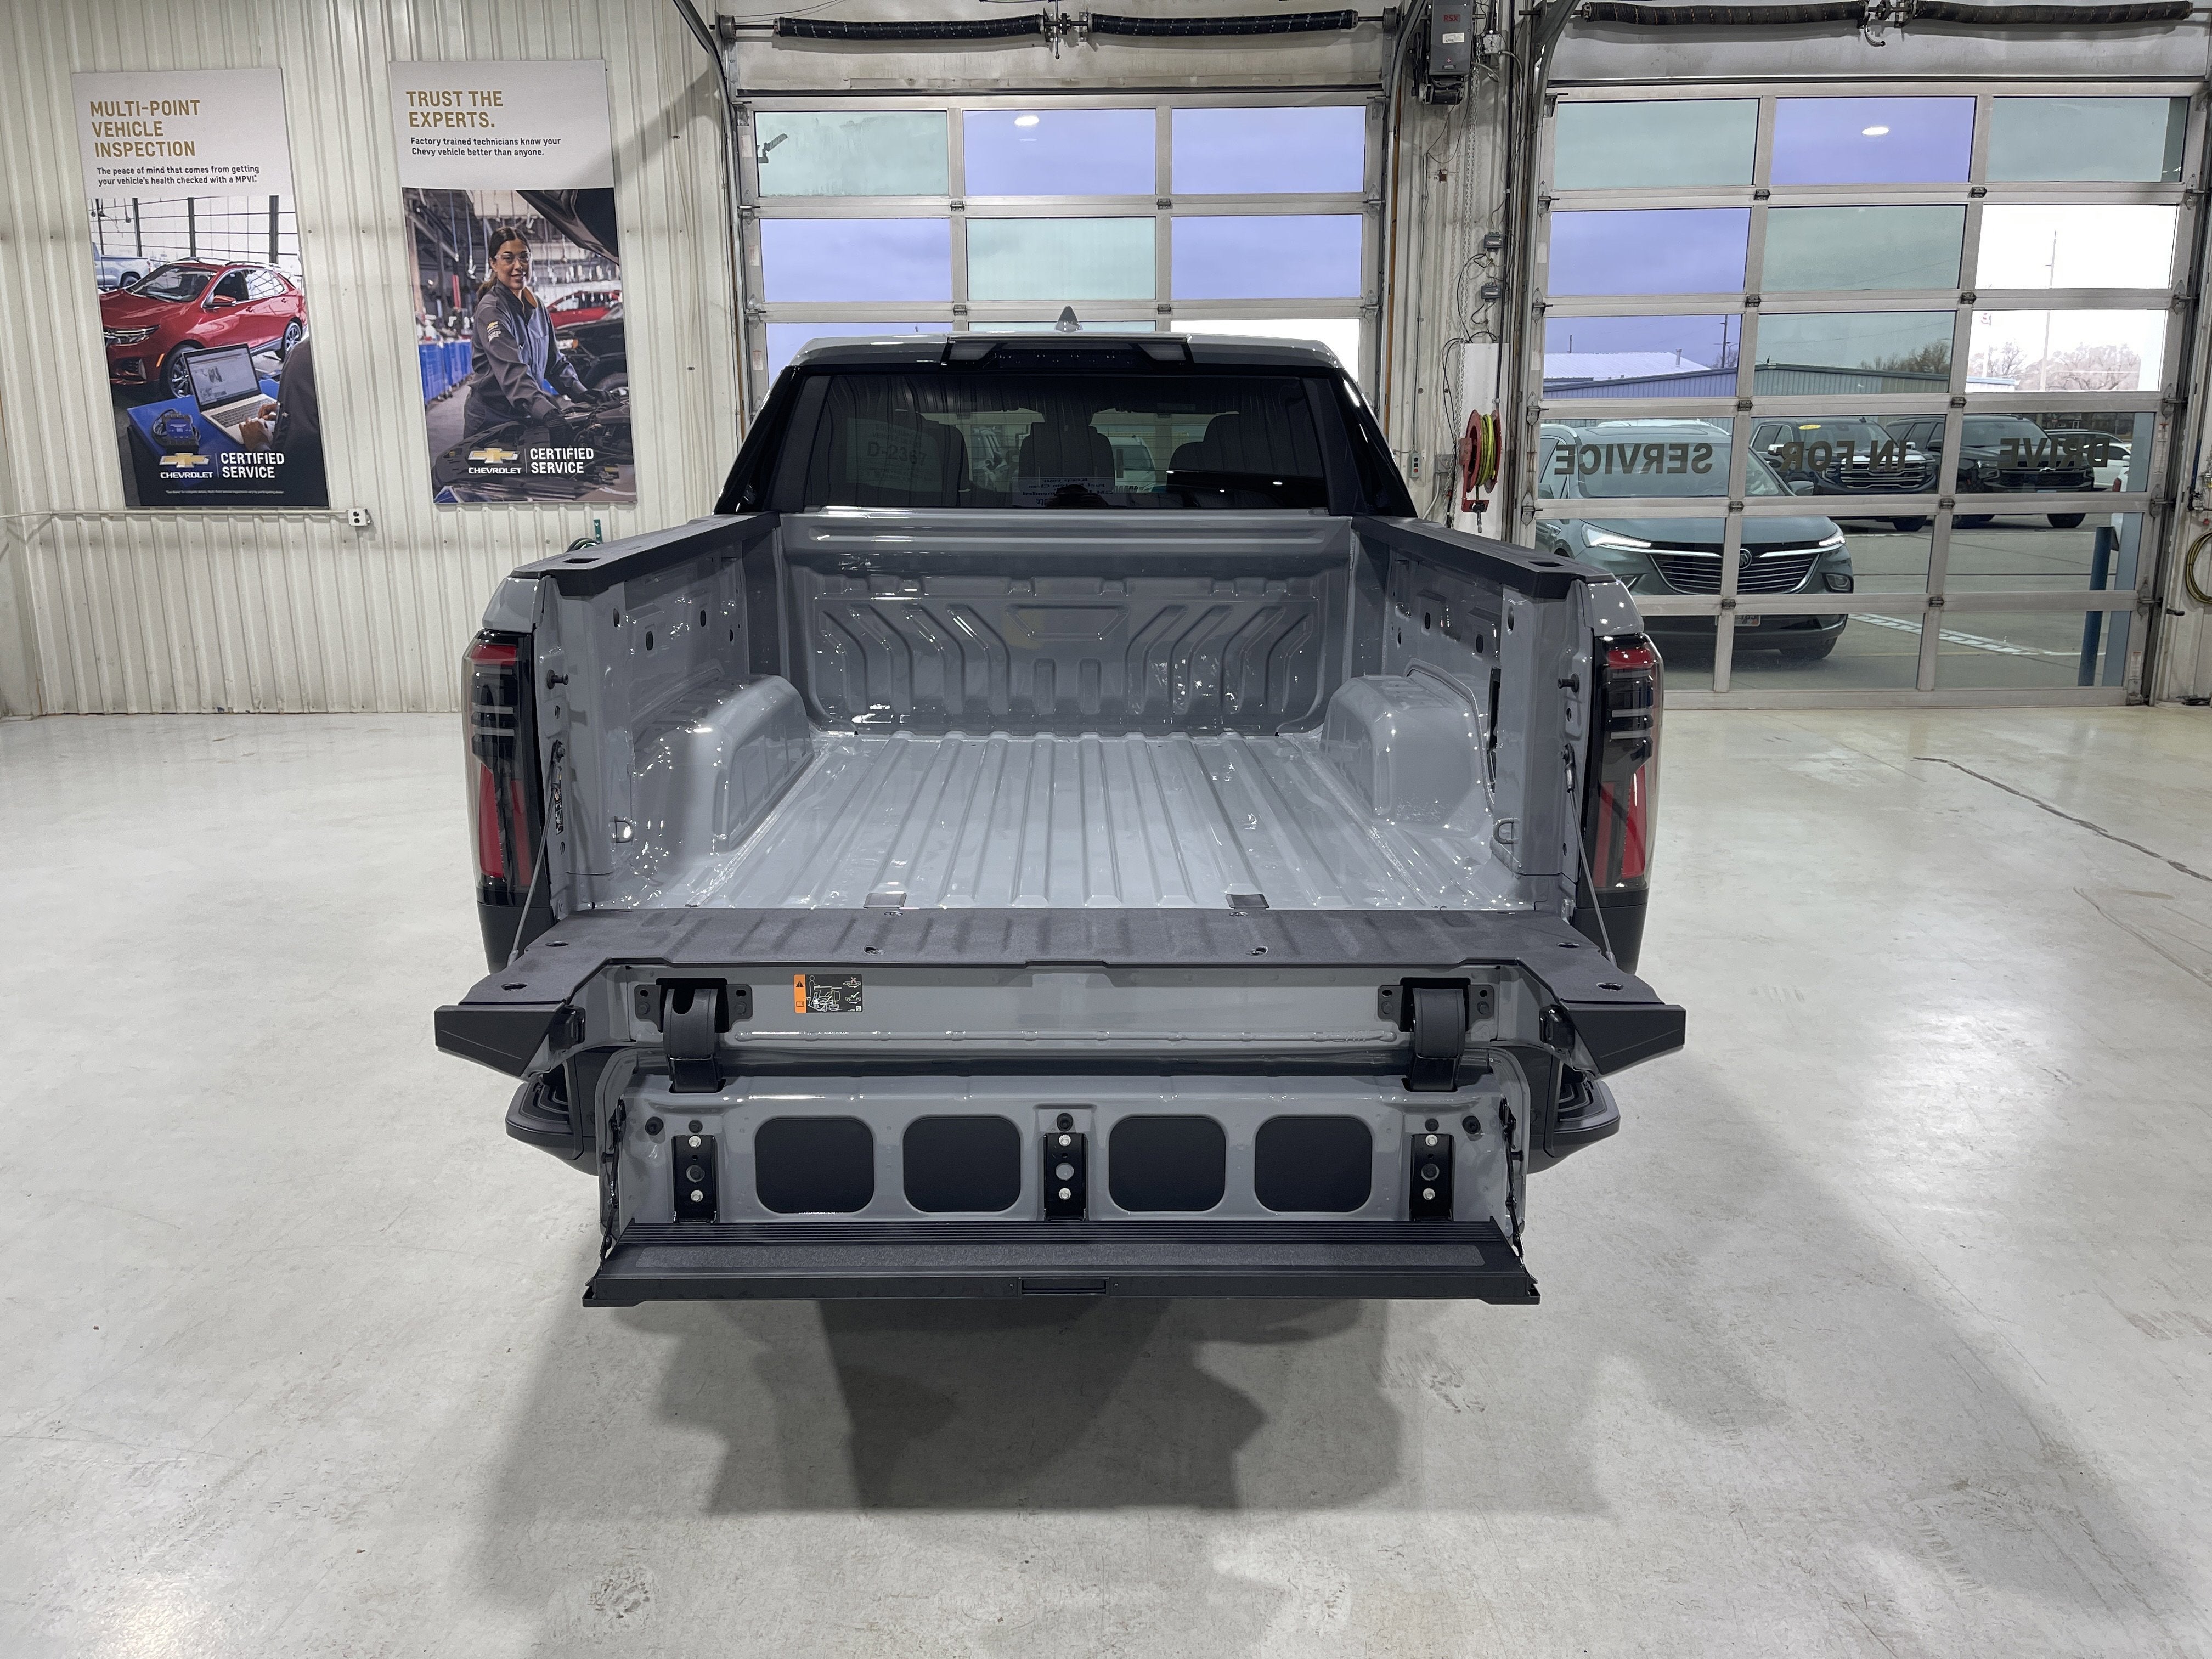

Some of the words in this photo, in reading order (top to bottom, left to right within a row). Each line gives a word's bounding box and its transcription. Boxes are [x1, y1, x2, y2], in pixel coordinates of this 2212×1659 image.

[406, 91, 463, 107] TRUST
[468, 91, 504, 107] THE
[90, 100, 200, 117] MULTI-POINT
[409, 111, 495, 128] EXPERTS.
[92, 121, 164, 137] VEHICLE
[411, 137, 441, 146] Factory
[443, 137, 471, 145] trained
[473, 137, 518, 145] technicians
[521, 137, 541, 145] know
[543, 138, 561, 146] your
[95, 140, 196, 158] INSPECTION
[411, 148, 436, 157] Chevy
[514, 149, 545, 157] anyone.
[113, 168, 135, 176] peace
[137, 166, 144, 174] of
[146, 166, 165, 174] mind
[232, 165, 259, 174] getting
[221, 452, 285, 464] CERTIFIED
[530, 448, 594, 460] CERTIFIED
[222, 466, 275, 478] SERVICE
[531, 462, 584, 473] SERVICE
